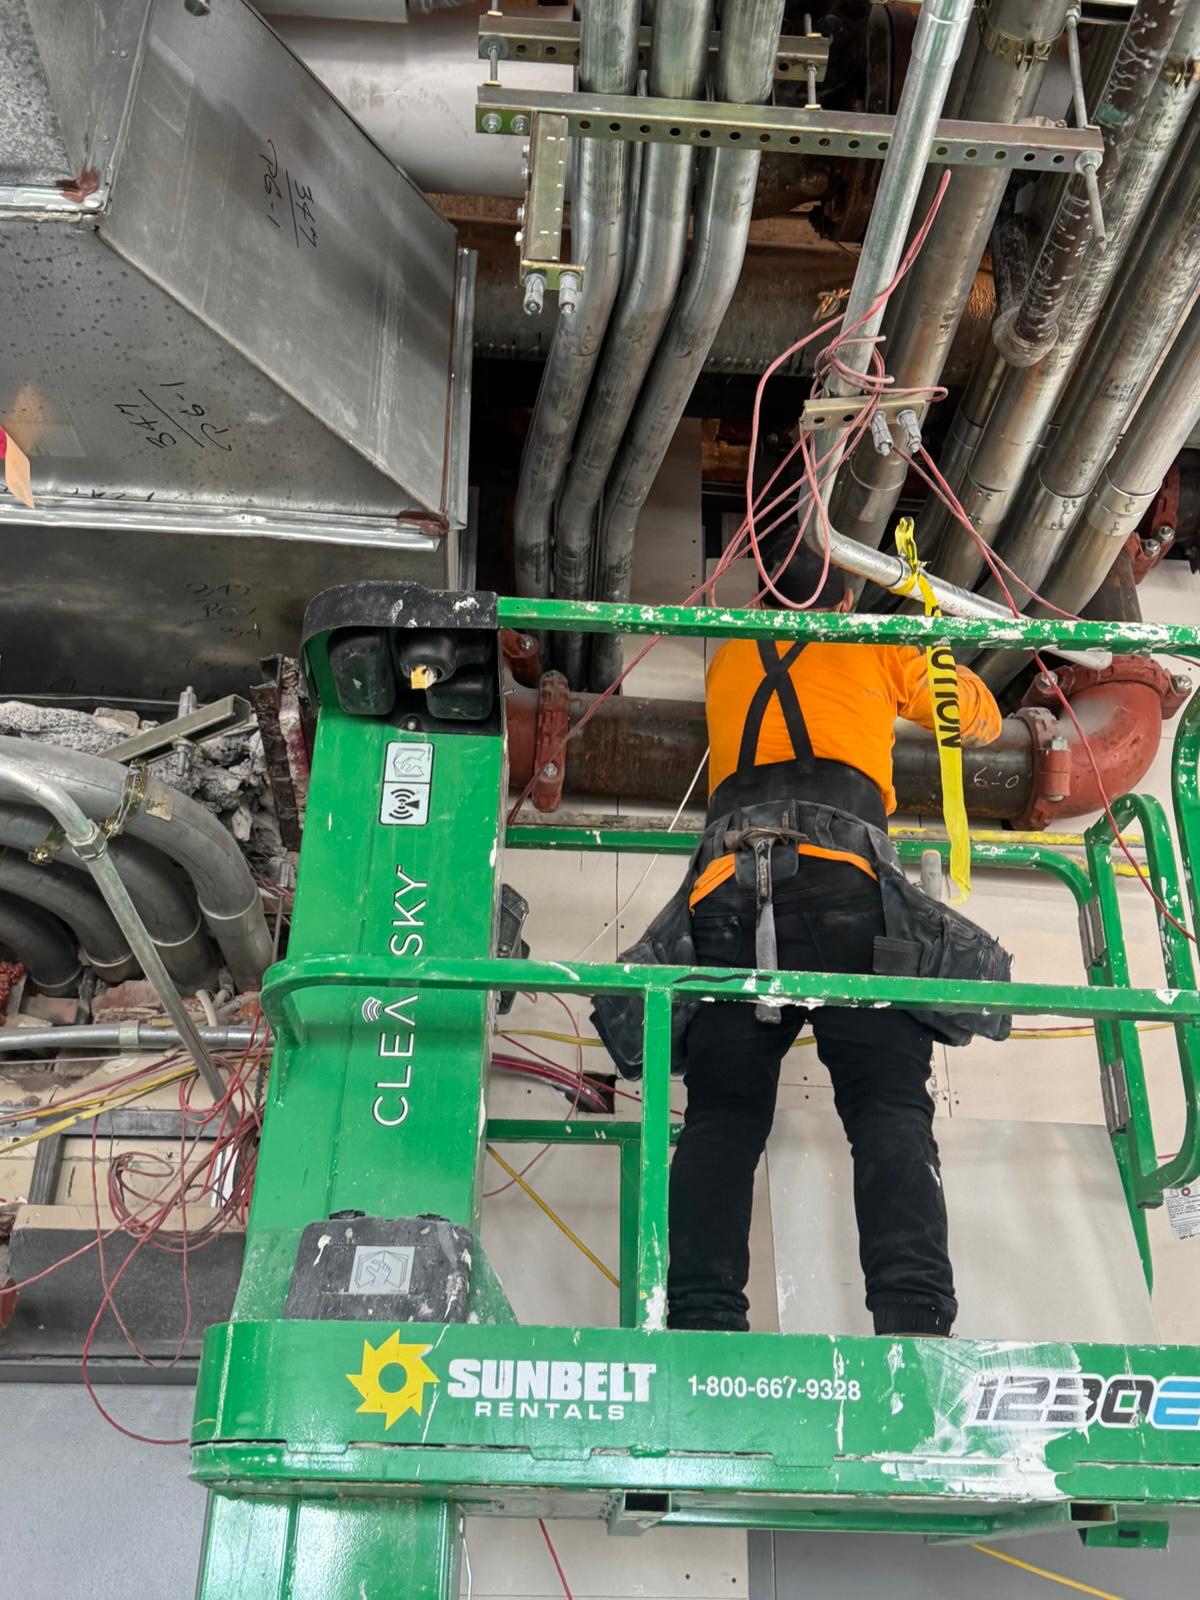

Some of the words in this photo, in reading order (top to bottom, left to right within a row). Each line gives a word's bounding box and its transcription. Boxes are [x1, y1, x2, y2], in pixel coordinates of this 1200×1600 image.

[931, 646, 961, 749] UTION
[370, 865, 428, 1127] CLEASKY
[447, 1358, 656, 1402] SUNBELT
[687, 1375, 862, 1401] 1-800-667-9328
[474, 1401, 625, 1420] RENTALS
